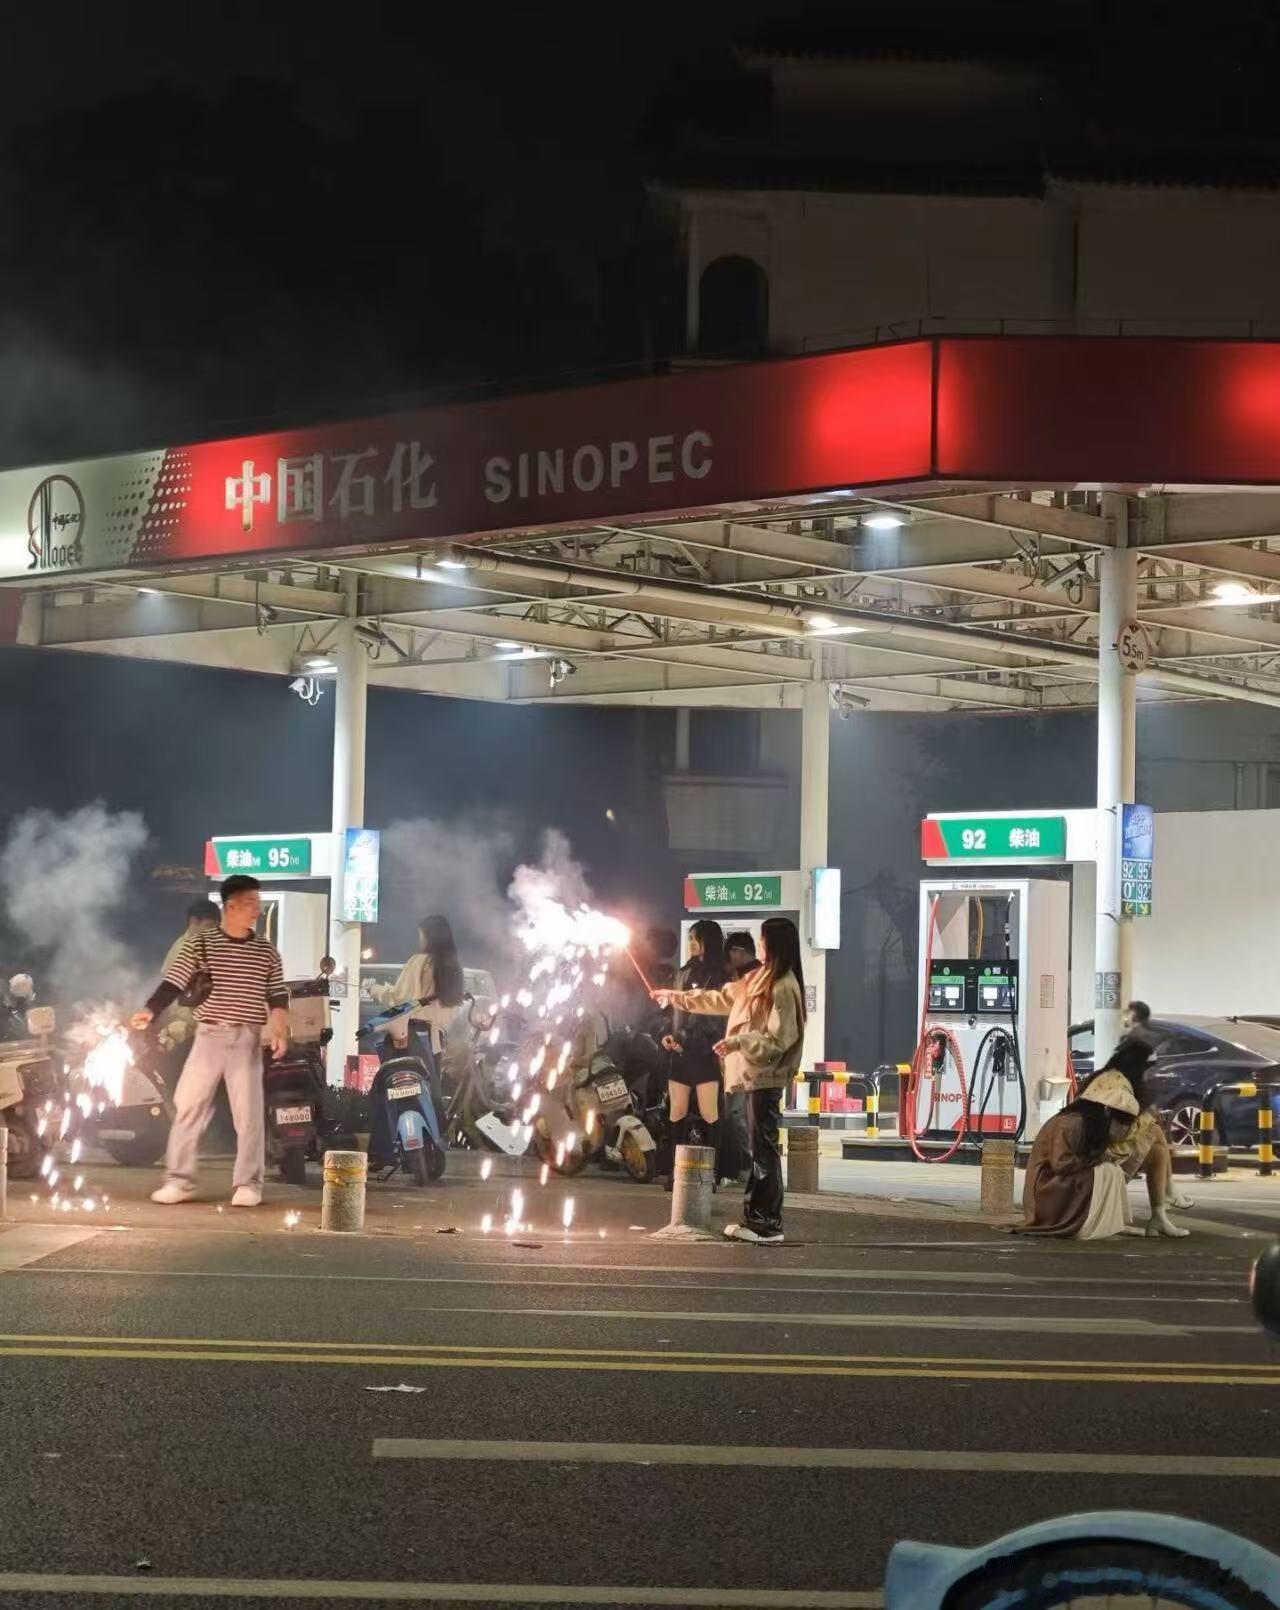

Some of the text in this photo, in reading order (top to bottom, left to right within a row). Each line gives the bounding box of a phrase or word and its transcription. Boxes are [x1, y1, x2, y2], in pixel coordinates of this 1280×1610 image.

[484, 430, 714, 503] SINOPEC
[225, 441, 437, 531] 中国石化
[962, 828, 1040, 849] 92 柴油
[268, 847, 290, 867] 95
[705, 885, 728, 901] 柴油
[744, 883, 763, 901] 92
[933, 1092, 976, 1103] SINOPC
